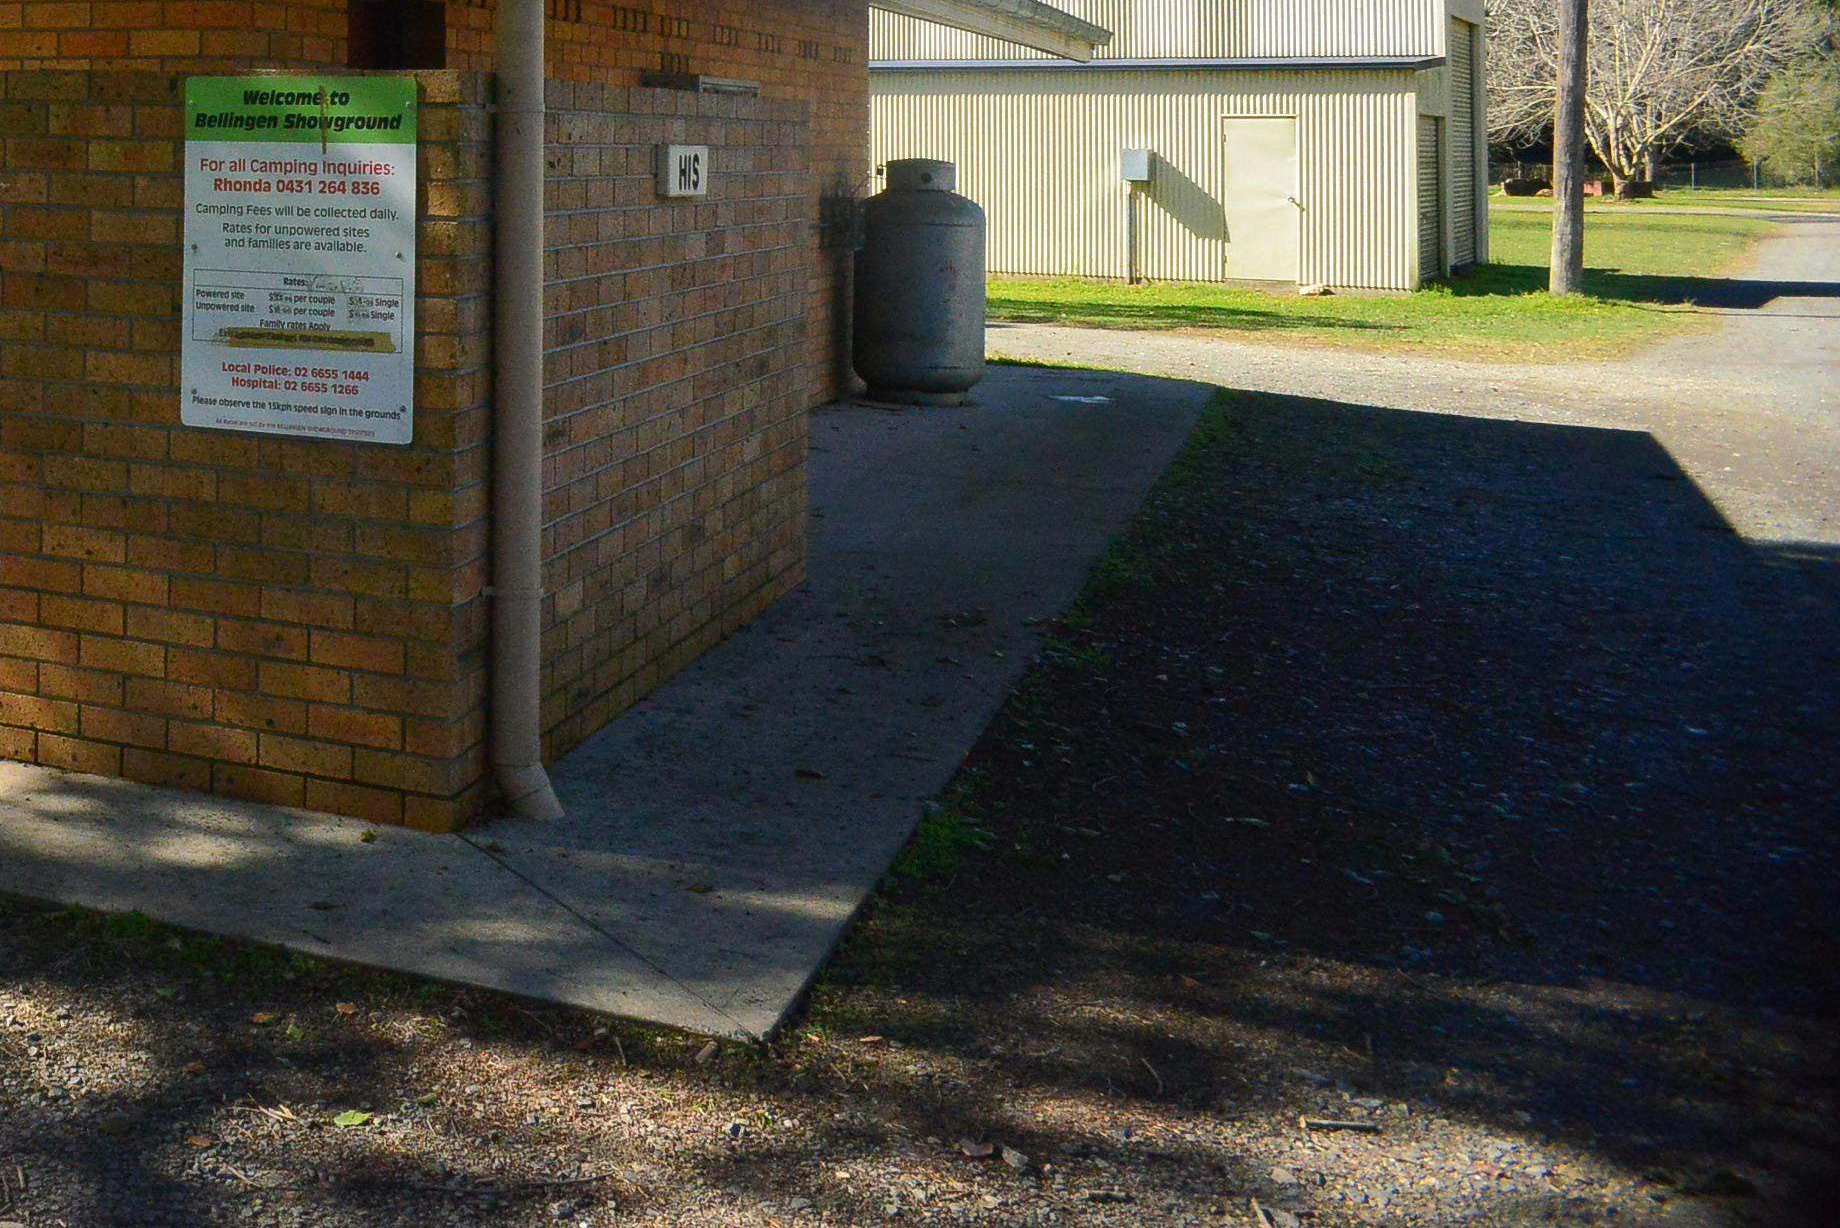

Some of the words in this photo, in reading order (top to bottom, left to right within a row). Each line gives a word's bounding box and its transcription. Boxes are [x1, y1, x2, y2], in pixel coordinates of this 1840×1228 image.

[243, 90, 321, 105] Welcome
[330, 91, 349, 105] to
[195, 113, 277, 130] Bellingen
[284, 114, 402, 131] Showground
[200, 158, 224, 172] For
[229, 158, 246, 172] all
[251, 159, 317, 175] Camping
[323, 161, 394, 176] Inquiries:
[678, 153, 700, 190] HIS
[214, 178, 271, 192] Rhonda
[276, 180, 312, 193] 0431
[318, 181, 346, 194] 264
[352, 182, 380, 195] 836
[196, 203, 243, 216] Camping
[247, 205, 271, 216] Fees
[275, 206, 293, 216] will
[297, 207, 310, 217] be
[314, 207, 366, 219] collected
[370, 208, 399, 220] daily.
[223, 223, 252, 234] Rates
[255, 223, 271, 234] for
[274, 225, 339, 237] unpowered
[343, 227, 369, 237] sites
[225, 237, 245, 248] and
[248, 238, 290, 249] families
[293, 240, 311, 250] are
[314, 241, 367, 252] available.
[196, 290, 229, 300] Powered
[231, 291, 244, 300] site
[293, 295, 307, 306] per
[241, 304, 254, 313] site
[293, 308, 307, 318] per
[222, 362, 251, 374] Local
[254, 364, 291, 376] Police:
[295, 367, 308, 378] 02
[311, 368, 338, 379] 6655
[342, 369, 369, 381] 1444
[232, 377, 281, 390] Hospital:
[284, 380, 297, 391] 02
[301, 381, 327, 393] 6655
[332, 383, 358, 395] 1266
[192, 396, 217, 405] Please
[219, 397, 250, 408] observe
[252, 399, 266, 409] the
[268, 402, 292, 412] 15kph
[294, 403, 318, 415] speed
[320, 406, 337, 416] sign
[339, 406, 347, 416] in
[349, 407, 363, 417] the
[365, 409, 400, 420] grounds
